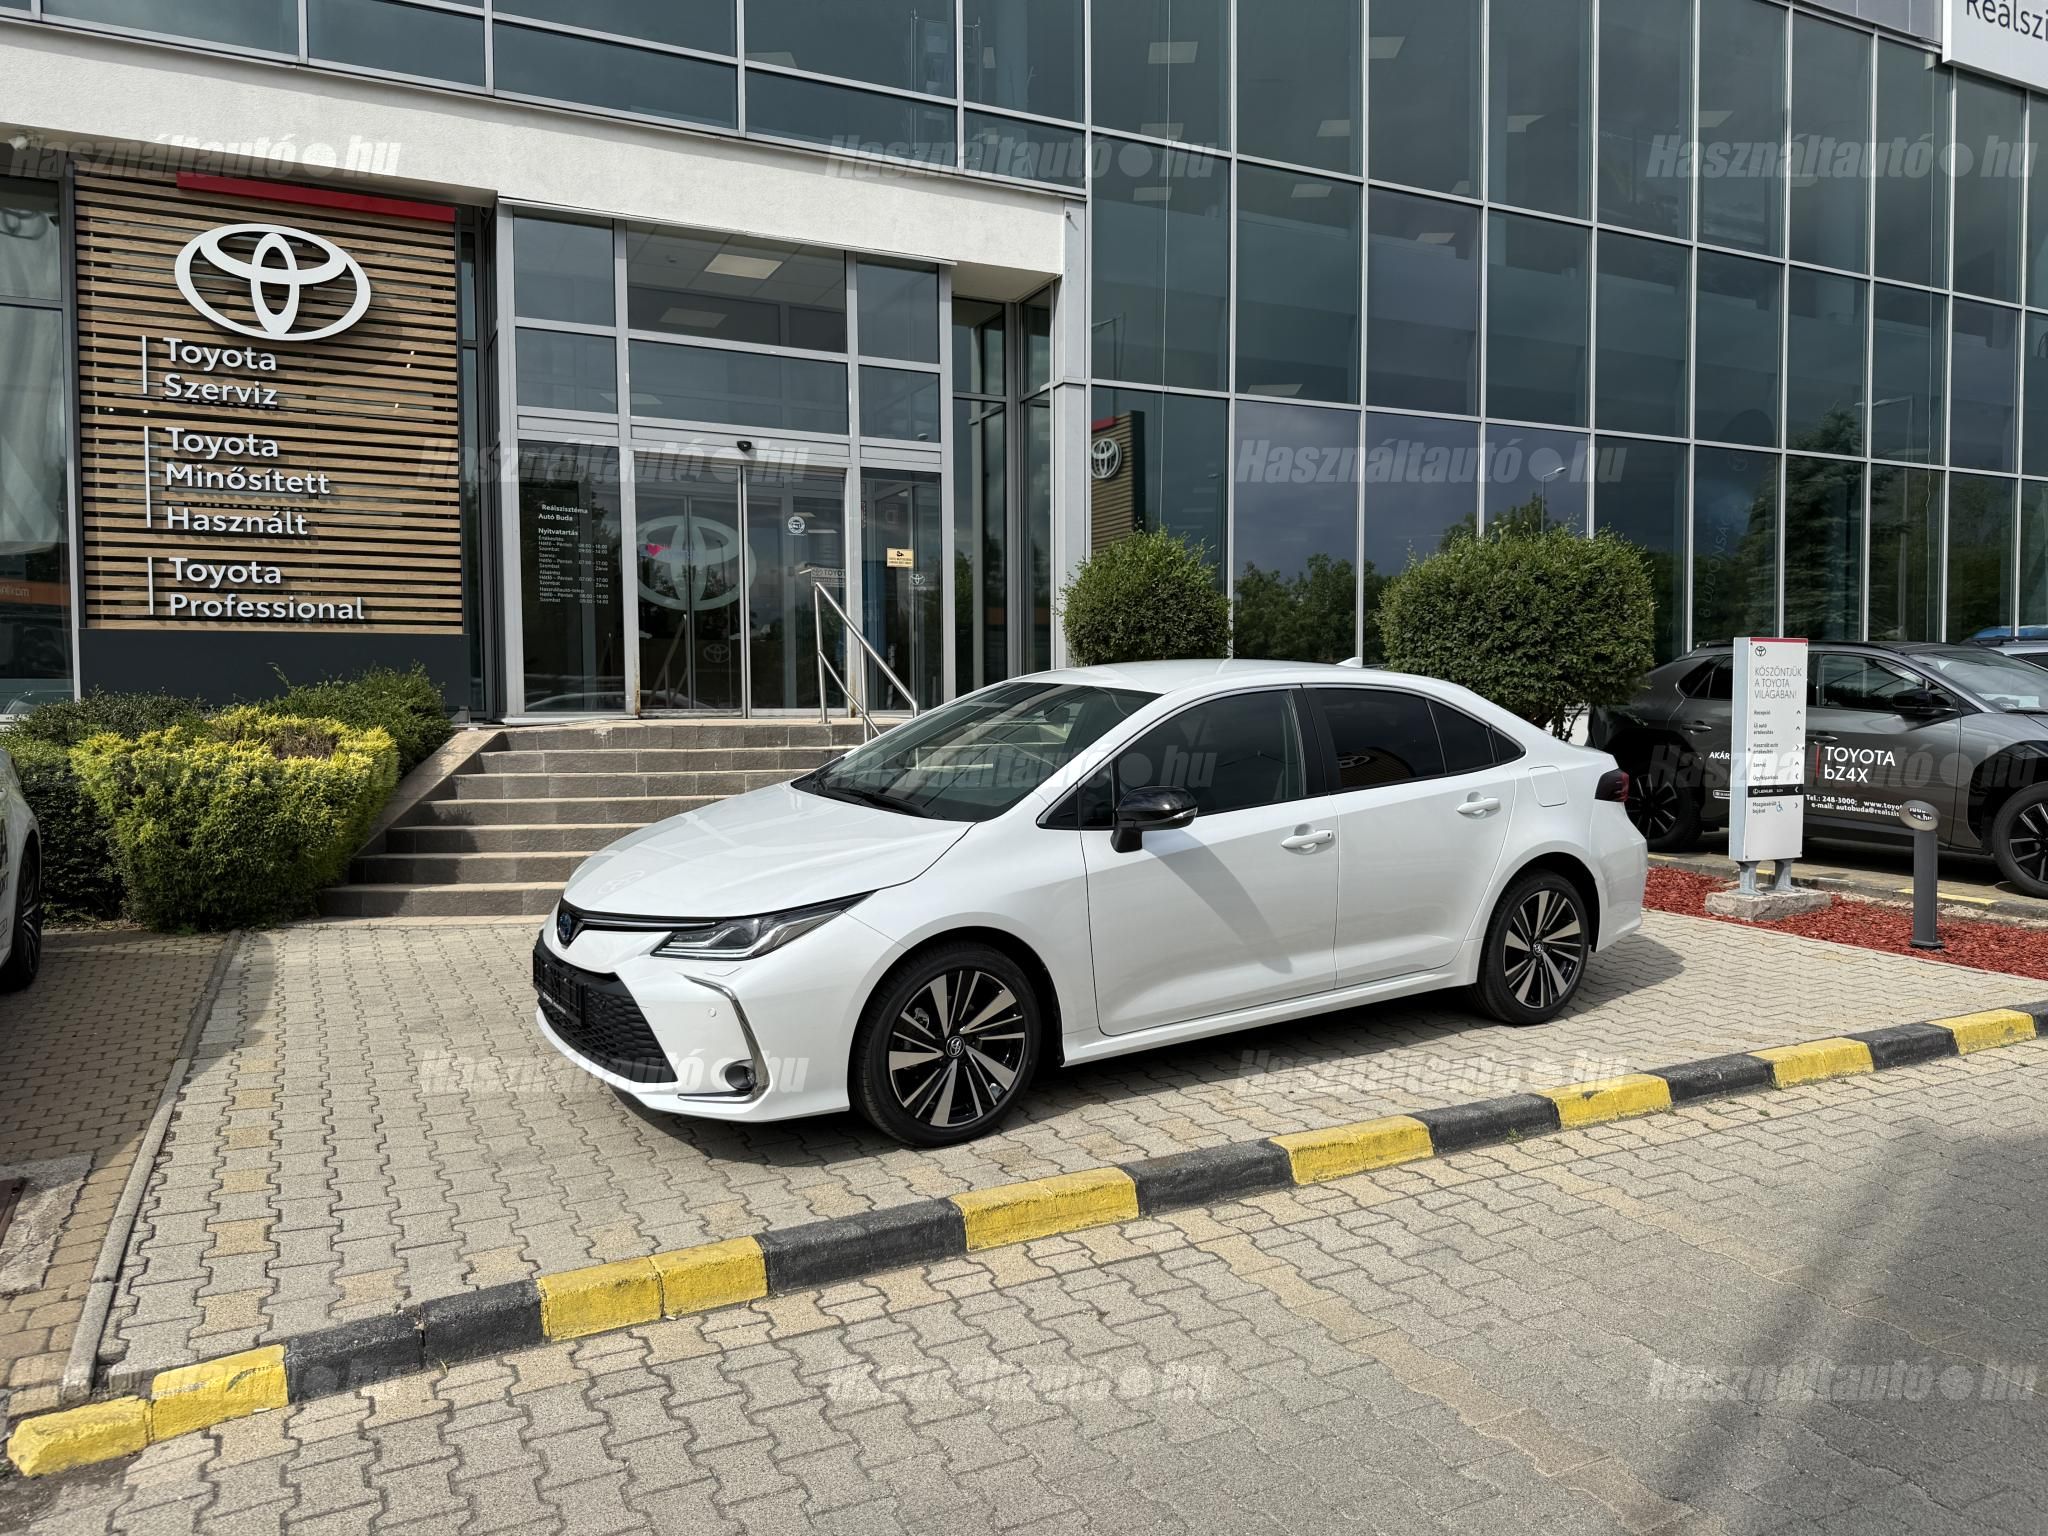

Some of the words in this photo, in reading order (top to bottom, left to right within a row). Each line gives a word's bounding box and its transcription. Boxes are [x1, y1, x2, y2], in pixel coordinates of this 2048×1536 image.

[163, 337, 277, 371] Toyota
[164, 373, 278, 405] Szerviz
[165, 426, 279, 460] Toyota
[166, 463, 330, 494] Minősített
[167, 506, 308, 535] Használt
[168, 557, 281, 589] Toyota
[169, 593, 365, 620] Professional
[1755, 679, 1760, 688] A
[1762, 679, 1790, 688] TOYOTA
[1709, 751, 1730, 759] AKÁR
[1824, 746, 1896, 766] TOYOTA
[1824, 764, 1868, 783] bZ4X
